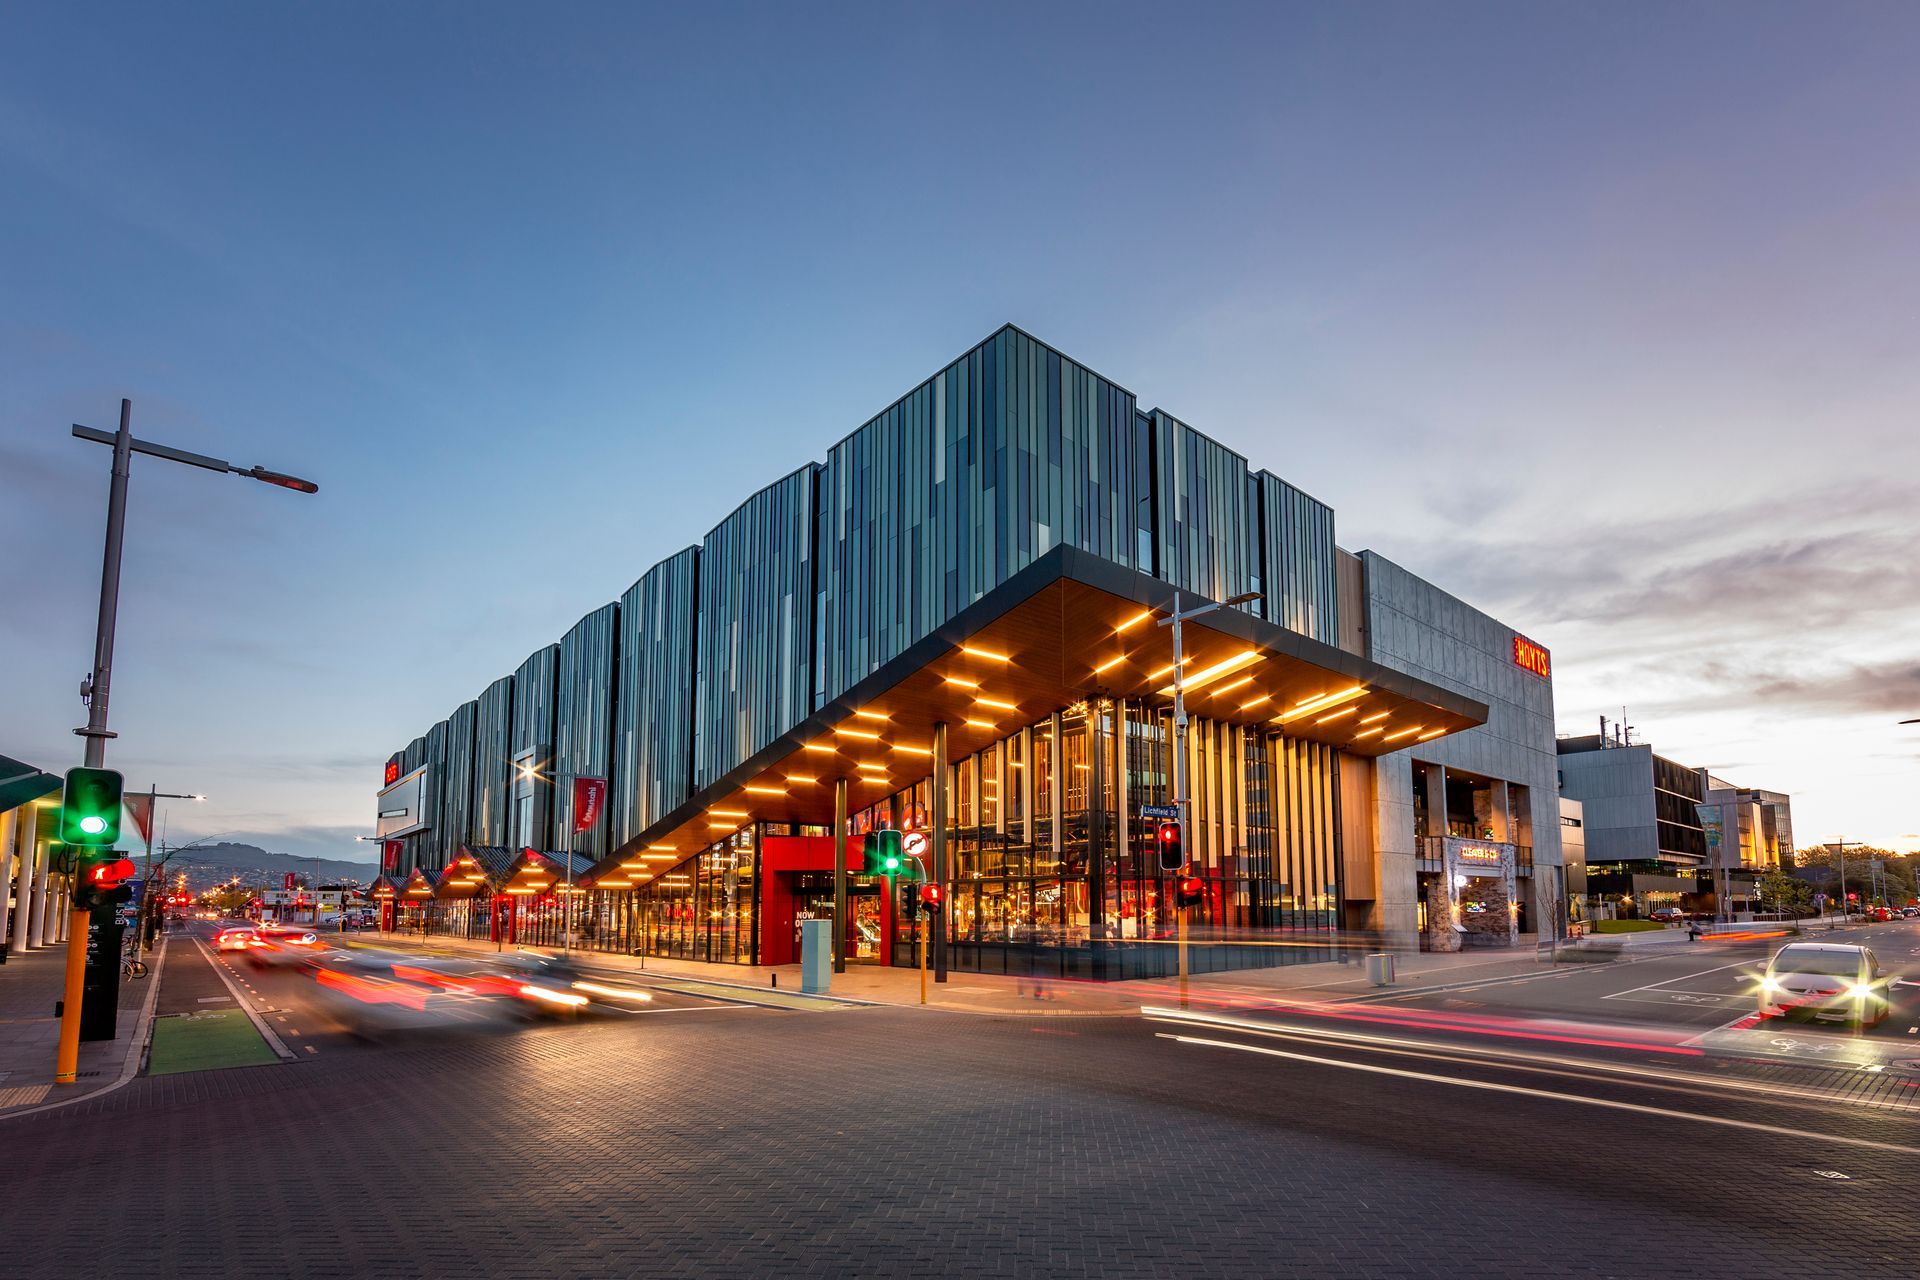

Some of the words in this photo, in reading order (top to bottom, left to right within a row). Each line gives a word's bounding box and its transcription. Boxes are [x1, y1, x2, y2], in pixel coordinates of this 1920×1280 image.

[1517, 639, 1547, 677] HOYTS
[1144, 806, 1169, 816] Lichfield
[1170, 809, 1177, 817] St
[115, 909, 125, 925] BUS
[796, 911, 815, 919] NOW
